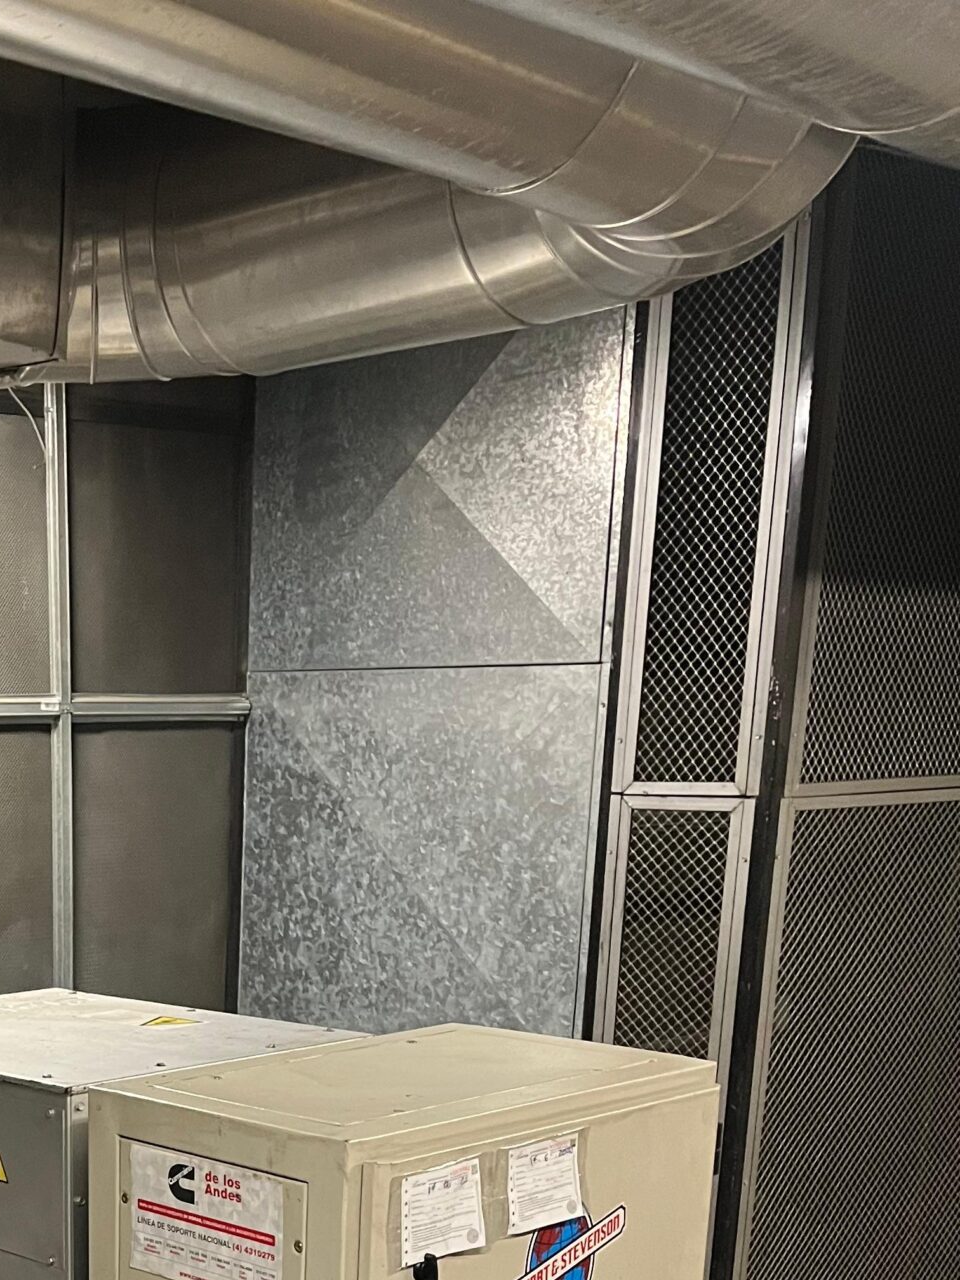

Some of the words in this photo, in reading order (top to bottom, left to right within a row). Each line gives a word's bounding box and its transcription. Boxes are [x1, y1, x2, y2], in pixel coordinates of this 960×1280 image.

[204, 1170, 219, 1184] de
[223, 1174, 241, 1190] los
[204, 1184, 242, 1203] Andes
[156, 1221, 166, 1230] DE
[167, 1223, 197, 1240] SOPORTE
[197, 1233, 231, 1249] NACIONAL
[232, 1242, 243, 1254] (4)
[551, 1258, 560, 1277] &
[560, 1213, 620, 1271] STEVENSON
